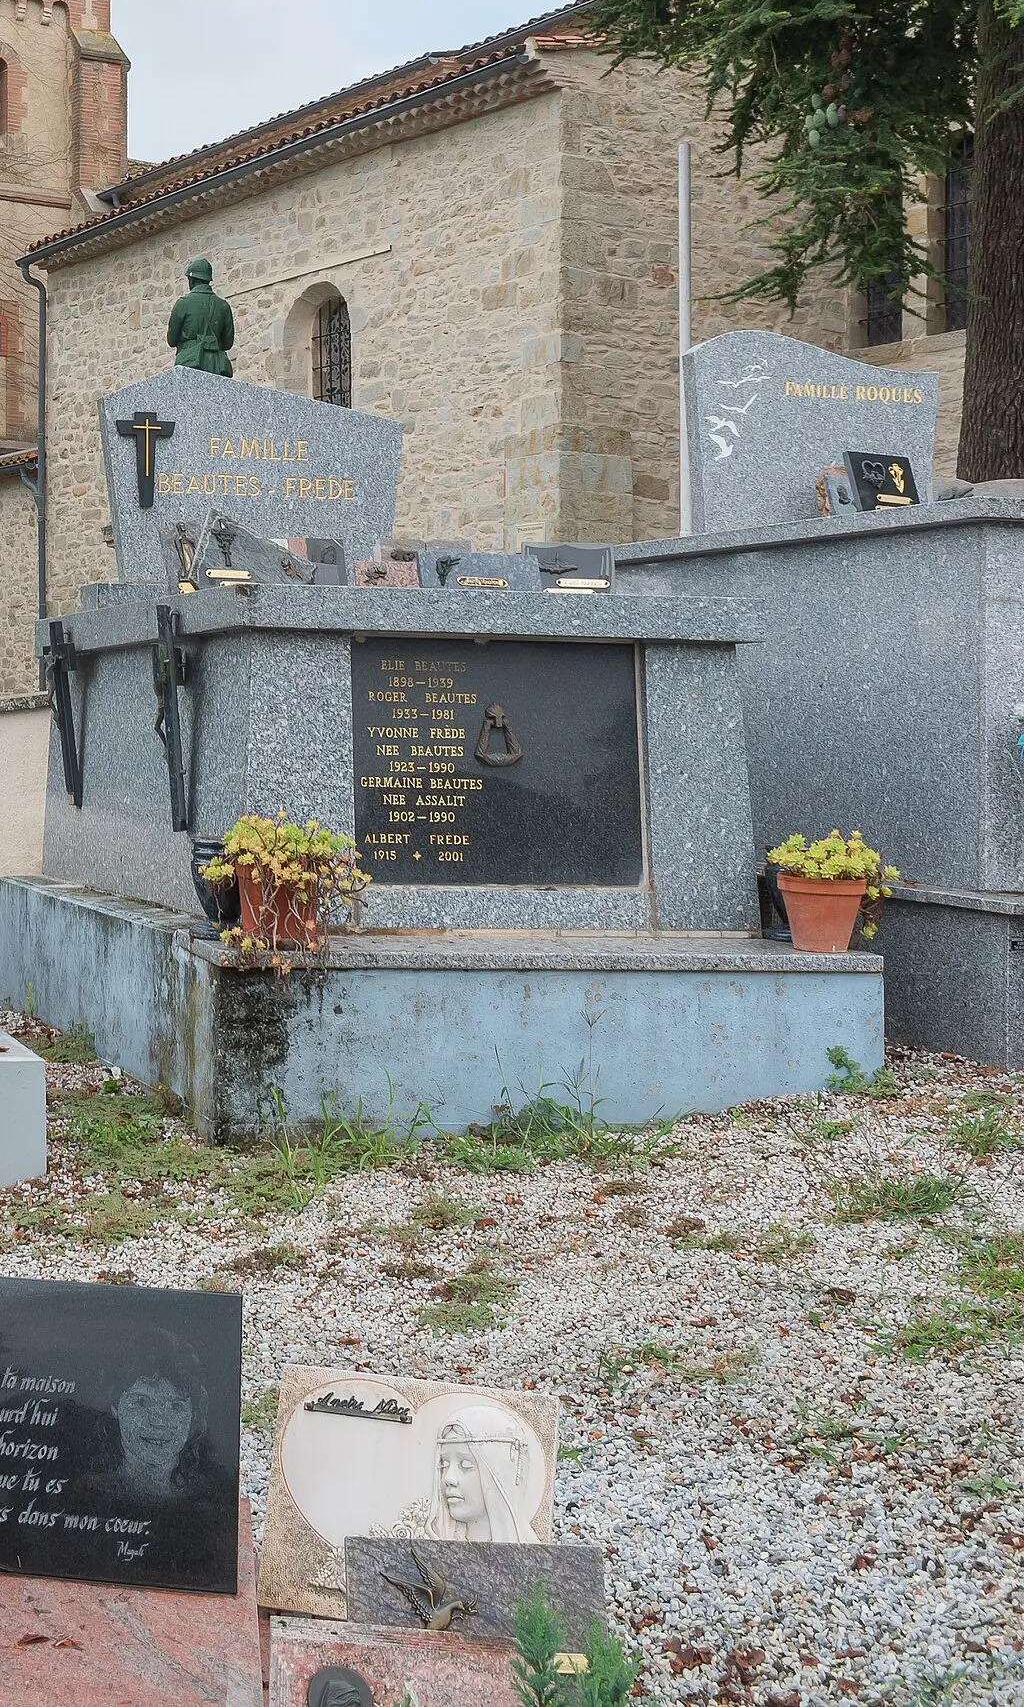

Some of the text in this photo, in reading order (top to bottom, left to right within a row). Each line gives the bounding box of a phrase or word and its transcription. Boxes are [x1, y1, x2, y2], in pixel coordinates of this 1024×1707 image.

[784, 380, 923, 405] FAMILLE ROQUES
[208, 436, 309, 462] FAMILLE
[156, 472, 262, 497] BEAUTES
[284, 476, 357, 501] FREDE
[380, 659, 468, 673] ELIE BEAUTES
[368, 690, 478, 705] ROGER BEAUTES
[367, 726, 419, 739] YVONNE
[376, 744, 464, 757] NEE BEAUTES
[360, 776, 483, 790] GERMAINE BEAUTES
[382, 793, 466, 807] NEE ASSALIT
[364, 833, 411, 844] ALBERT
[374, 849, 464, 862] 1915 2001
[0, 1363, 18, 1390] ta
[20, 1375, 77, 1394] maison
[21, 1466, 43, 1492] tu
[45, 1478, 70, 1495] es
[17, 1497, 67, 1529] dans
[64, 1512, 102, 1532] mon
